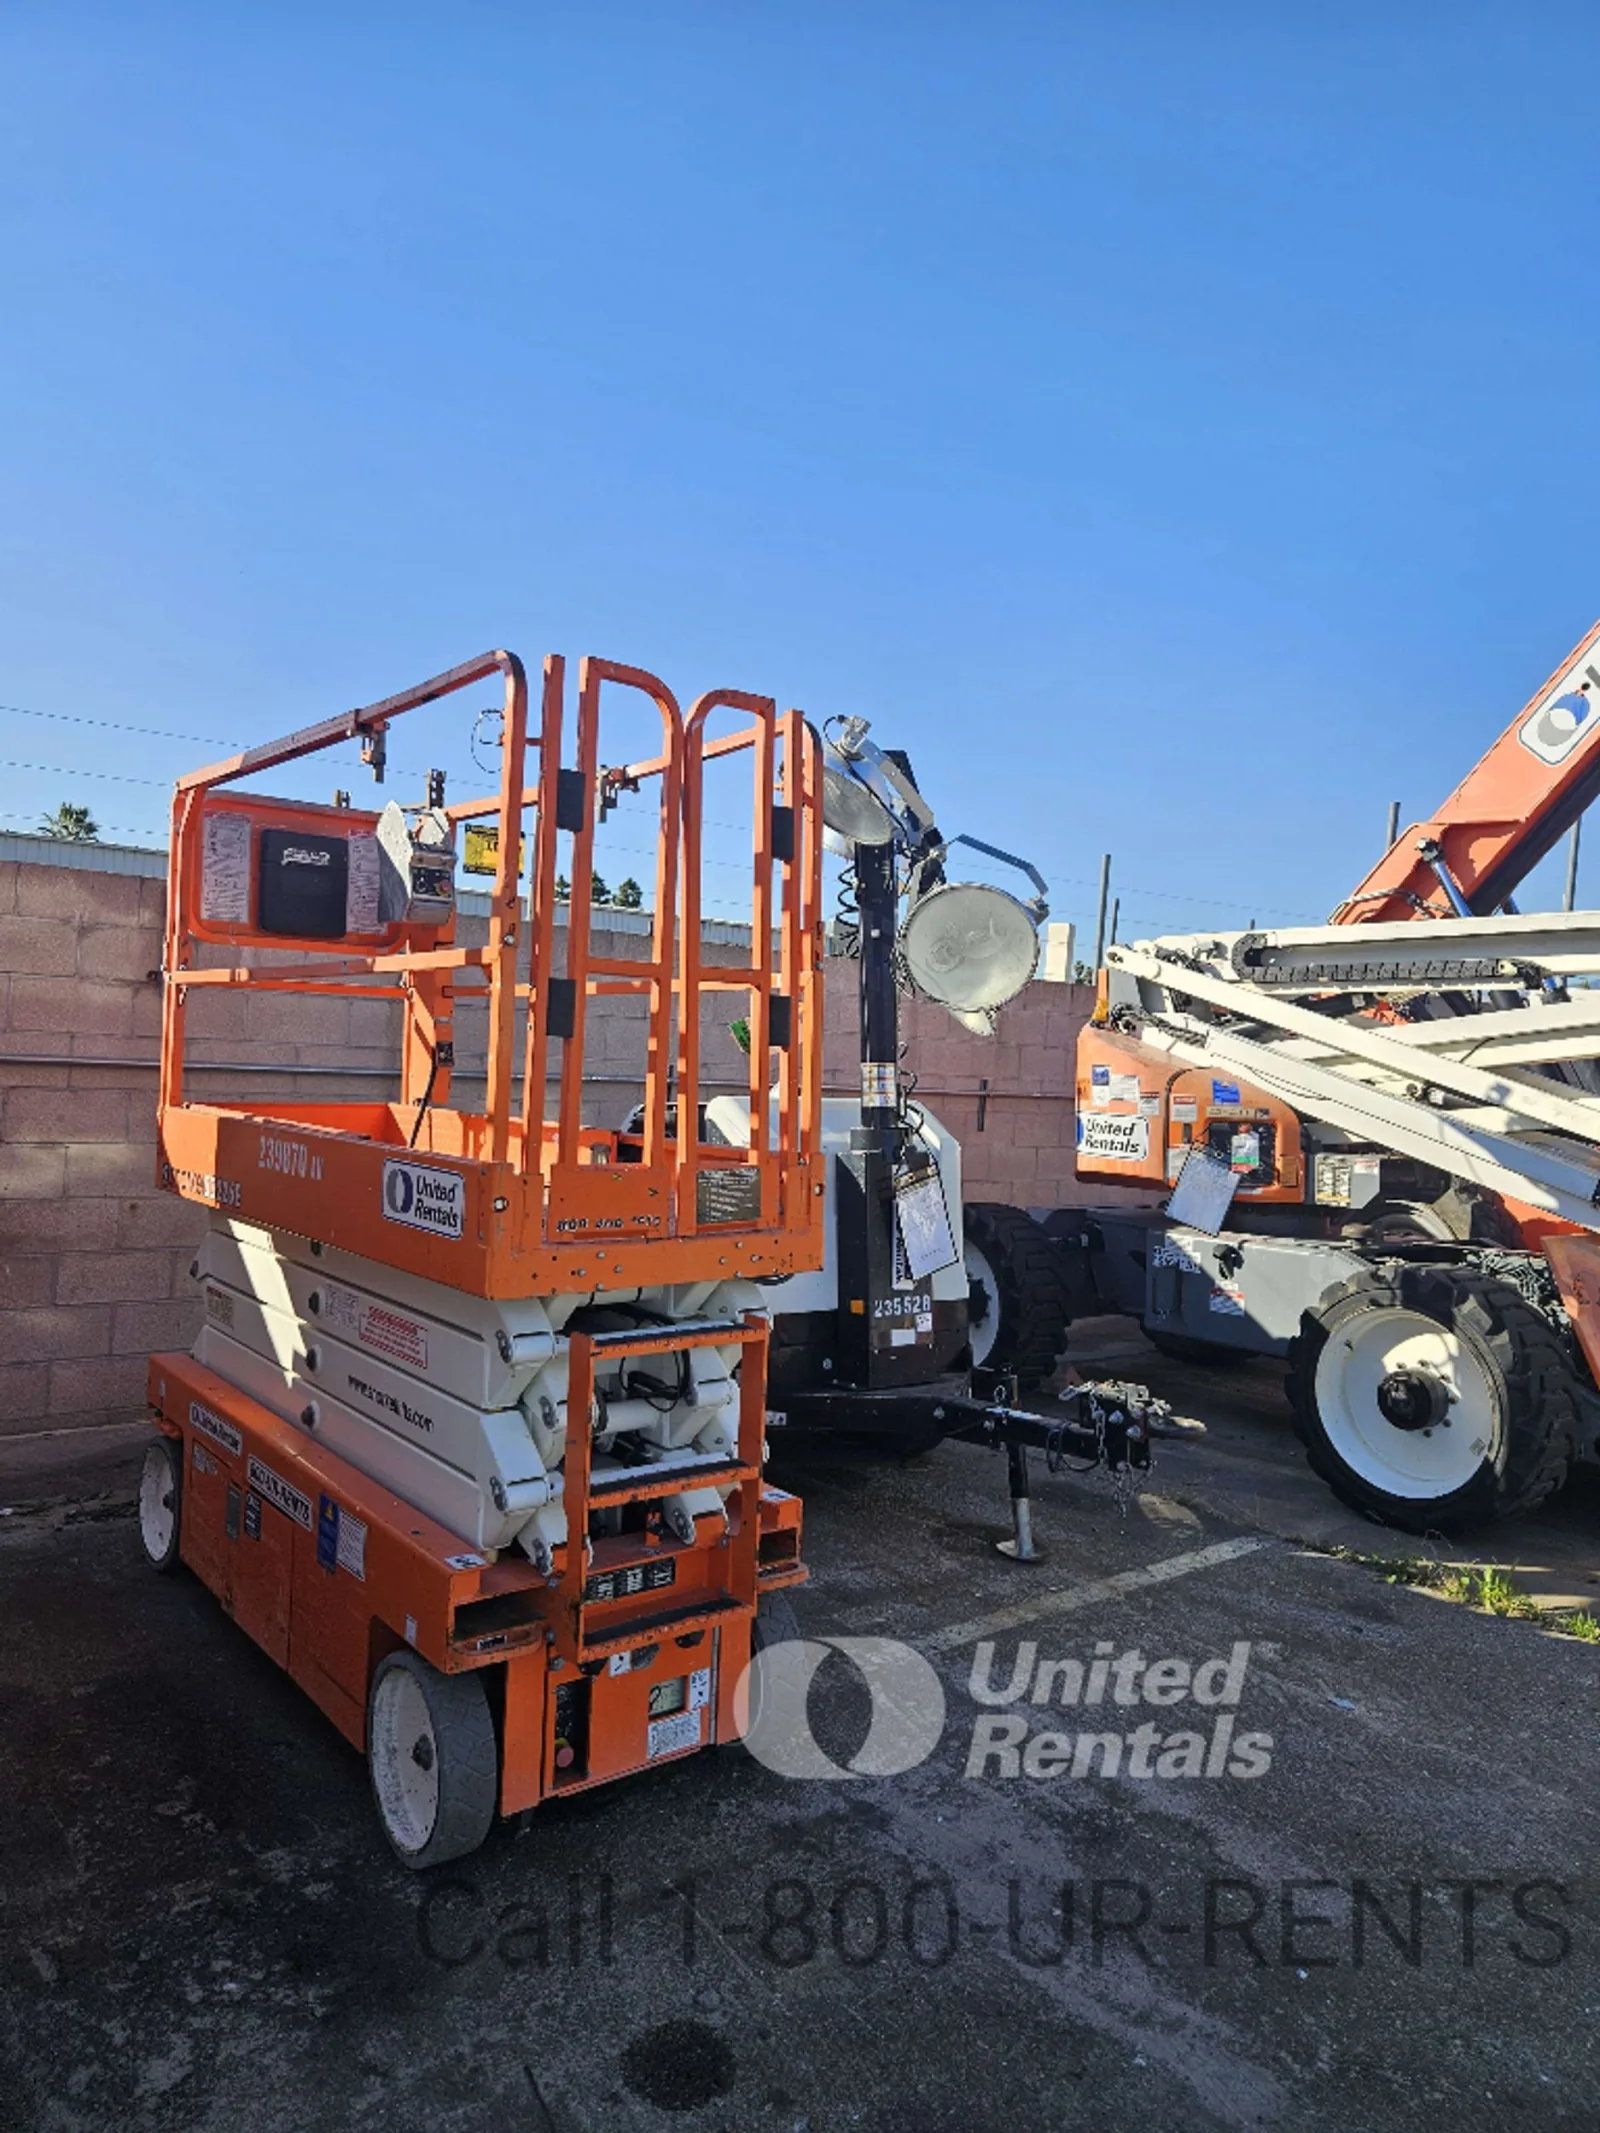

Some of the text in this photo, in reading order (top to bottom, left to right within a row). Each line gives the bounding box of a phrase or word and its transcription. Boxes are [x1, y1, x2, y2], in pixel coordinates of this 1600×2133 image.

[1085, 1119, 1137, 1136] United
[1084, 1134, 1140, 1153] Rentals
[416, 1175, 459, 1203] United
[414, 1198, 459, 1228] Rentals
[874, 1294, 931, 1318] 235528
